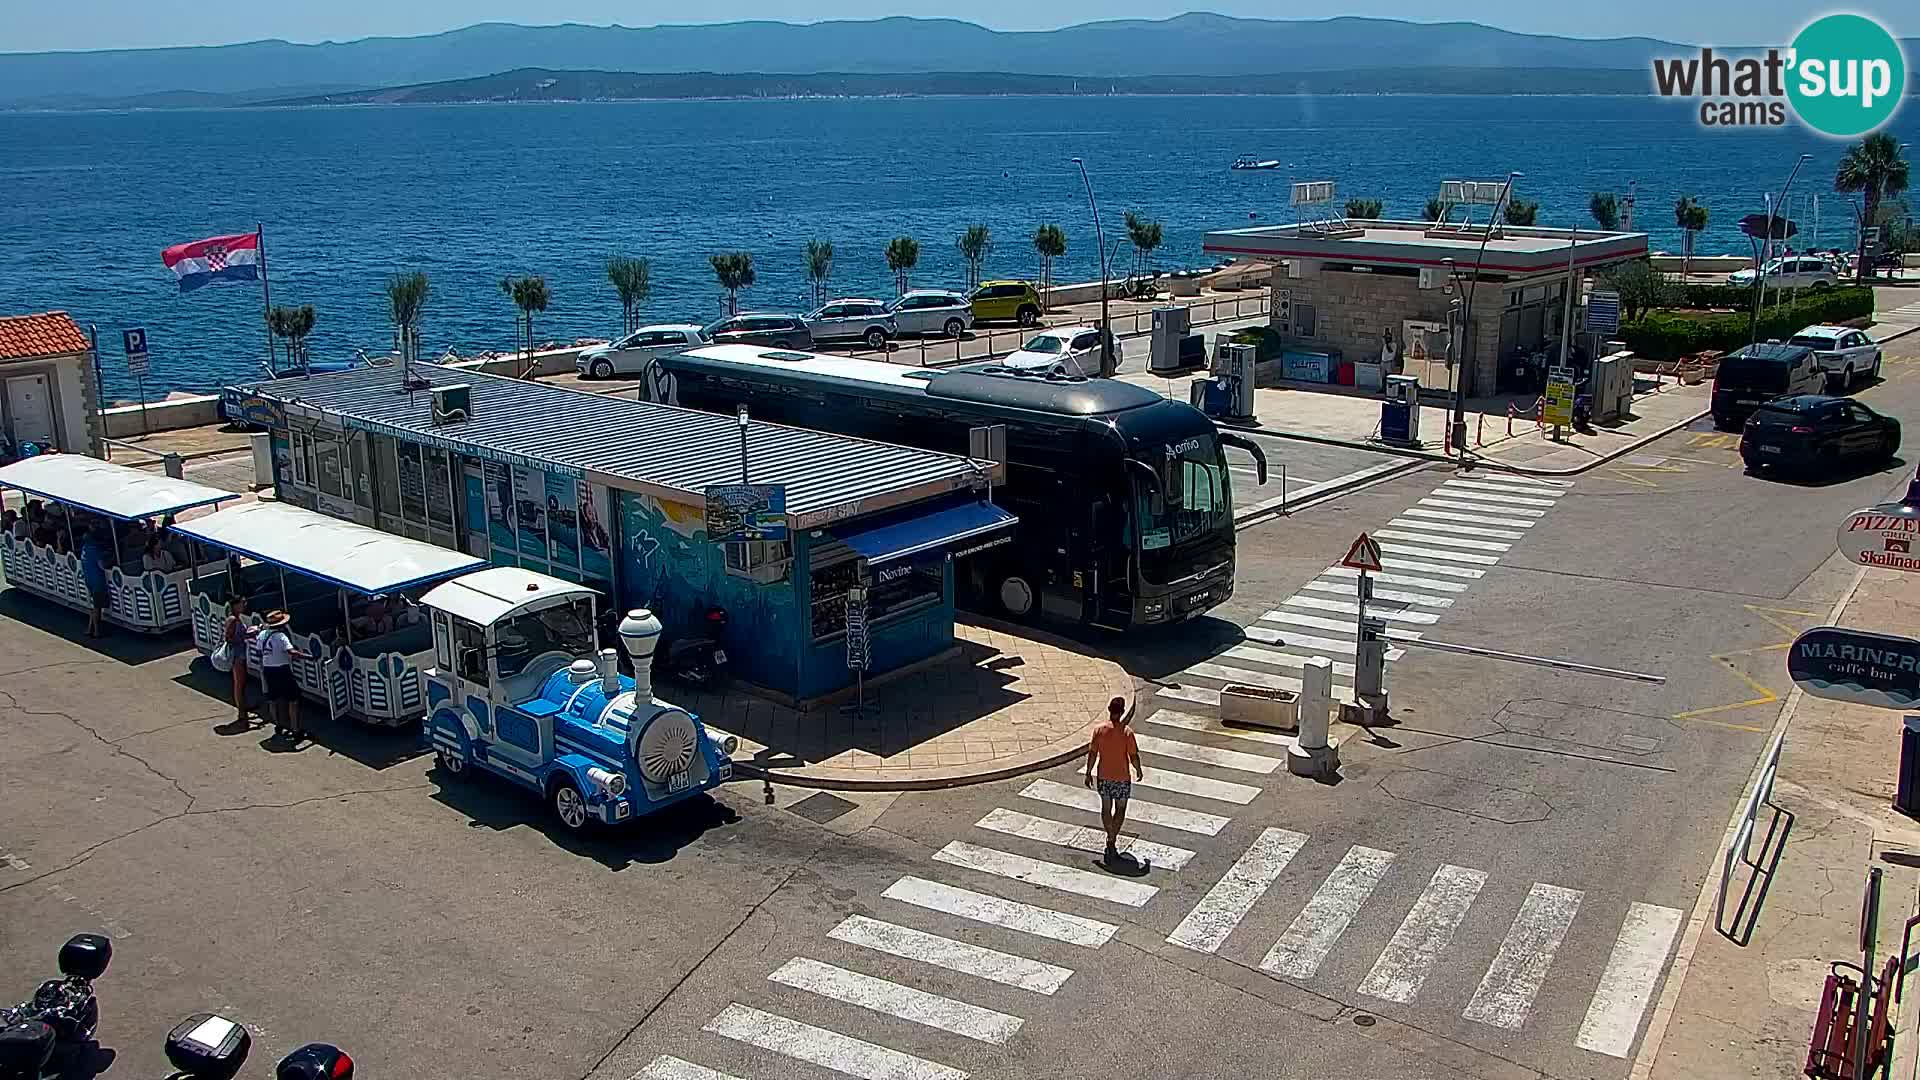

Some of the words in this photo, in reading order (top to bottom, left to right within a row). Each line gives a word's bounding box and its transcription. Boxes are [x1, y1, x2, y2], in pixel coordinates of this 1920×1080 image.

[477, 446, 491, 459] BUS
[493, 449, 526, 466] STATION
[527, 457, 553, 474] TICKET
[554, 462, 581, 479] OFFICE
[1848, 516, 1920, 535] PIZZE
[1882, 530, 1917, 541] GRILL
[1828, 663, 1865, 675] caffe
[1870, 667, 1896, 680] bar
